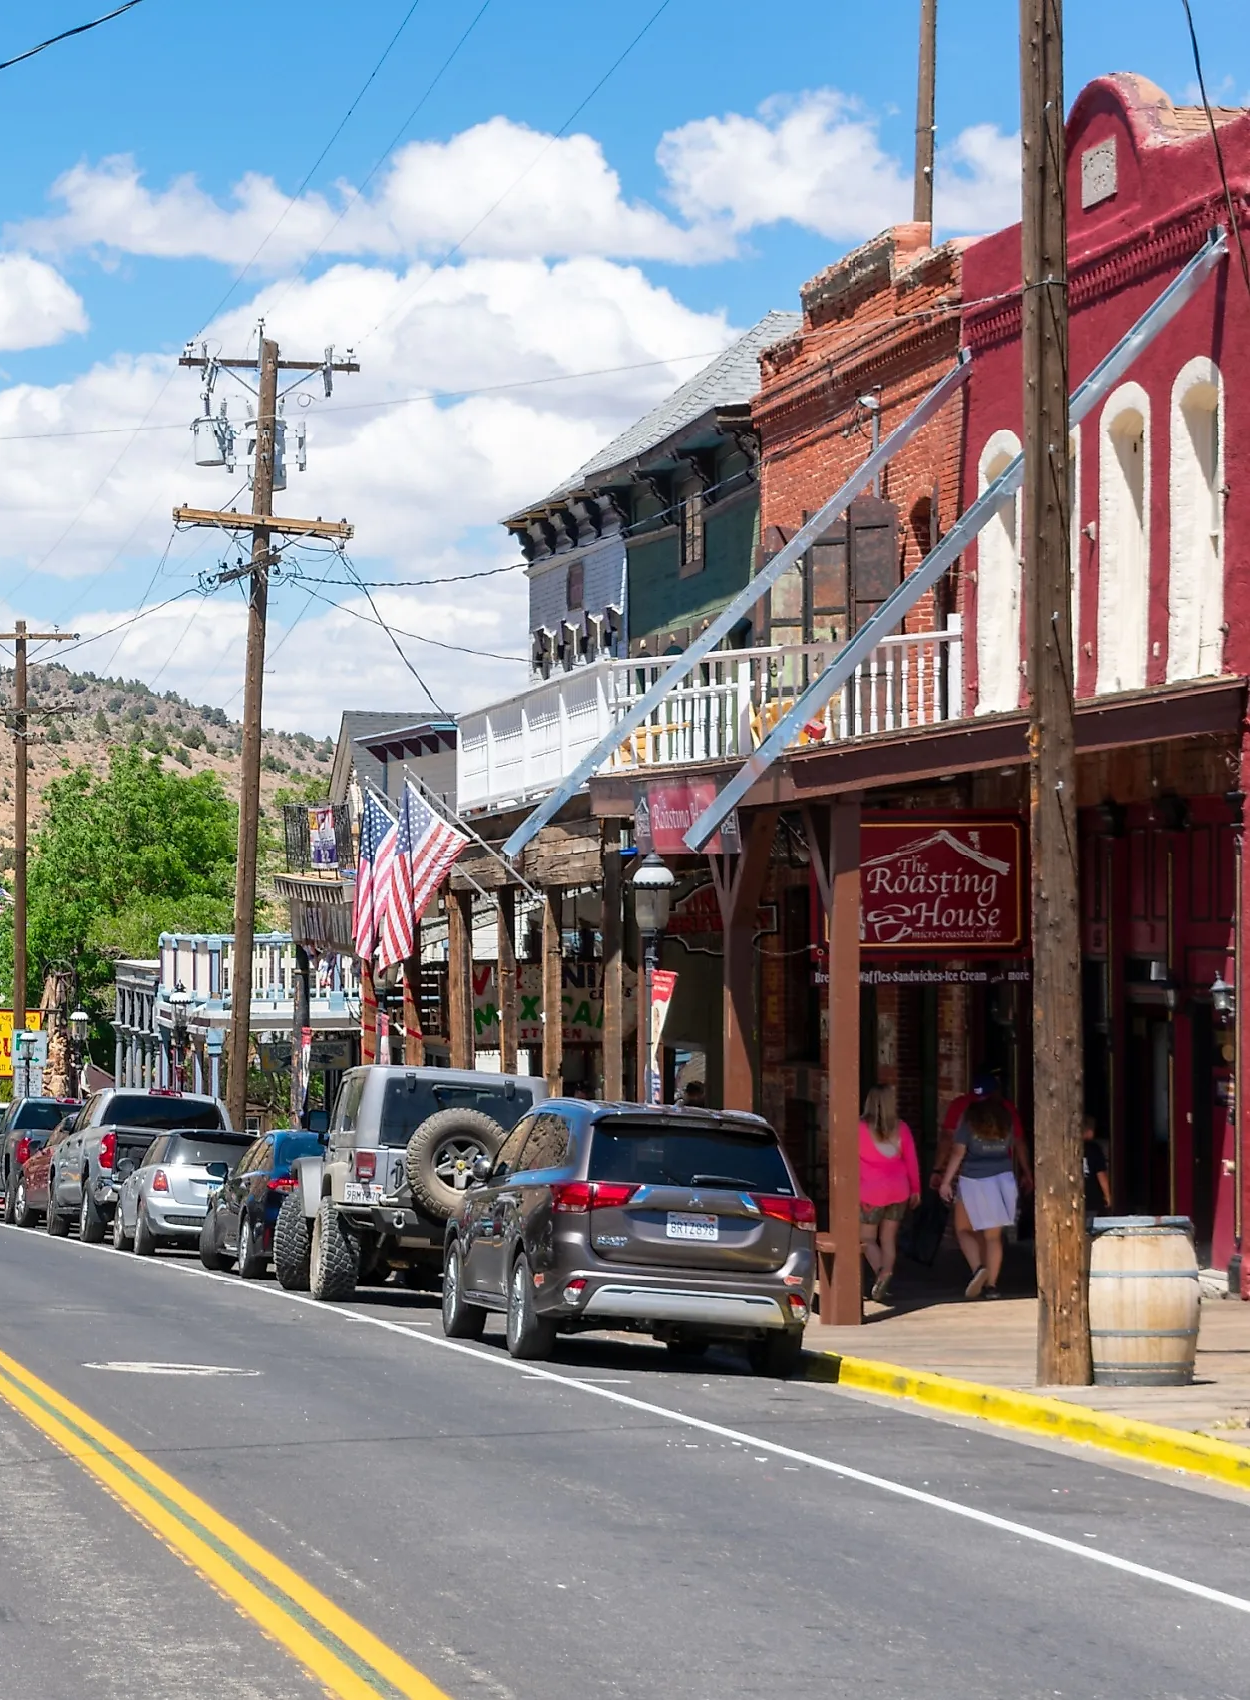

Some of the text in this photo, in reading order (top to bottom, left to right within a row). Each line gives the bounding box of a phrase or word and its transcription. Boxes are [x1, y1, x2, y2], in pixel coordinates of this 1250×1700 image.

[898, 854, 929, 874] The
[866, 866, 999, 907] Roasting
[911, 893, 1000, 928] House
[911, 927, 1002, 943] micro-roasted coffee
[814, 971, 830, 984] Bre
[959, 970, 987, 982] Cream
[1007, 970, 1031, 982] more
